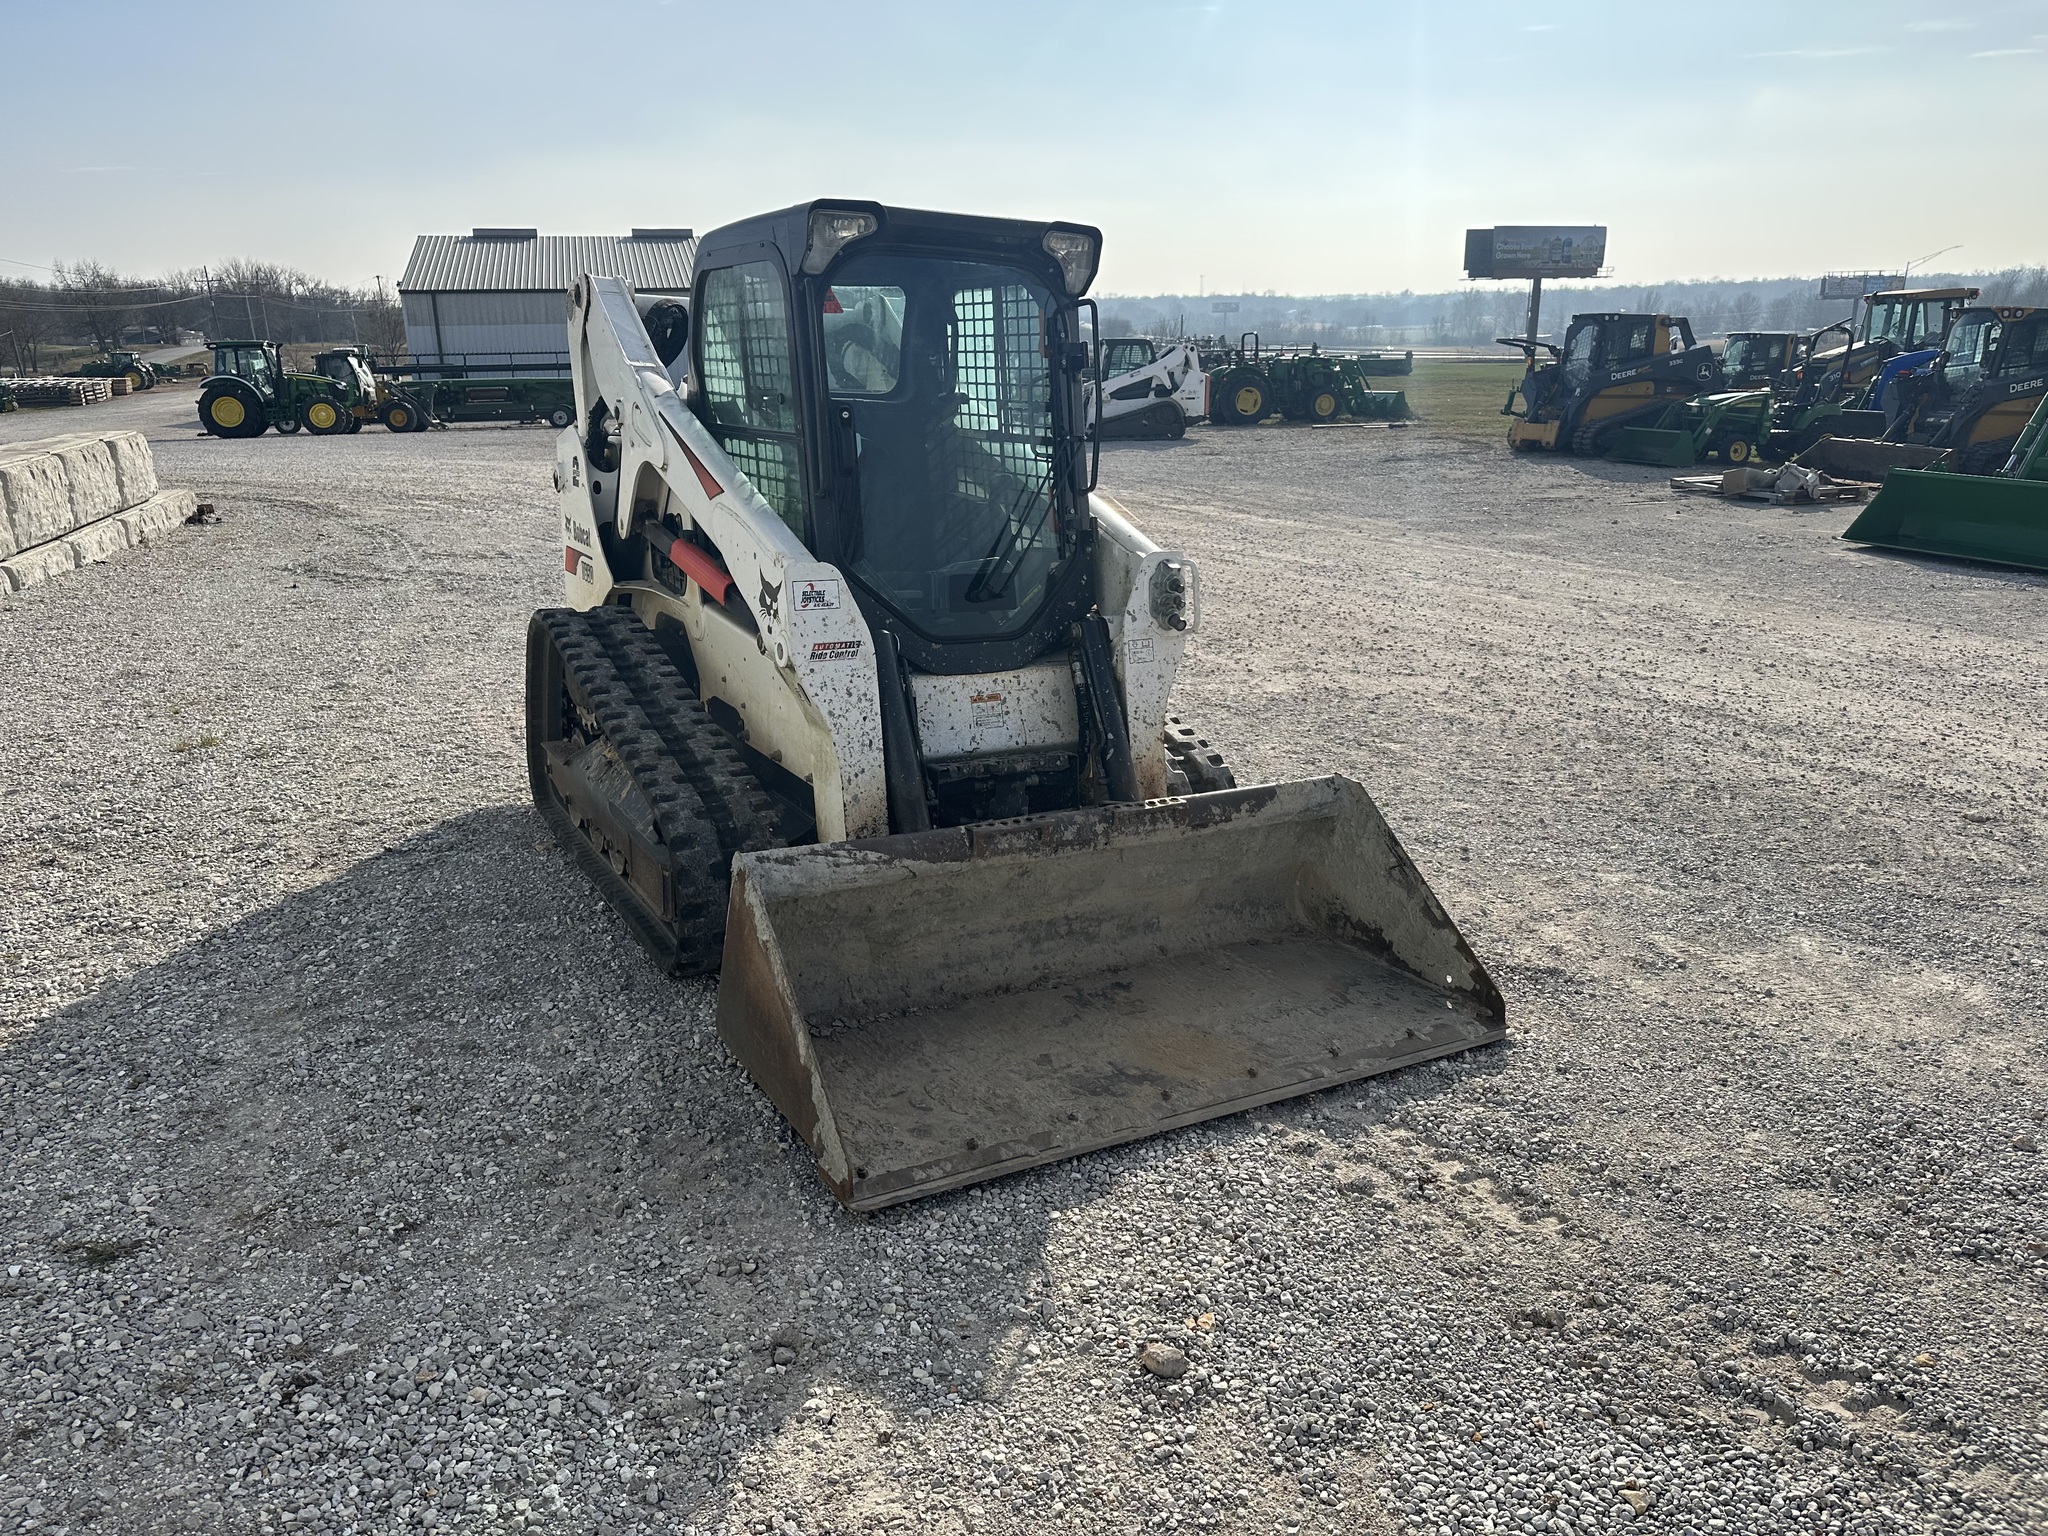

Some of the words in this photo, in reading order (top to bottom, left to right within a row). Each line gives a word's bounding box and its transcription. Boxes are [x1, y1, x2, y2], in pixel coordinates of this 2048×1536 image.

[1611, 368, 1637, 380] DEERE
[2010, 378, 2043, 393] DEERE
[810, 651, 828, 660] Ride
[829, 648, 859, 659] Control
